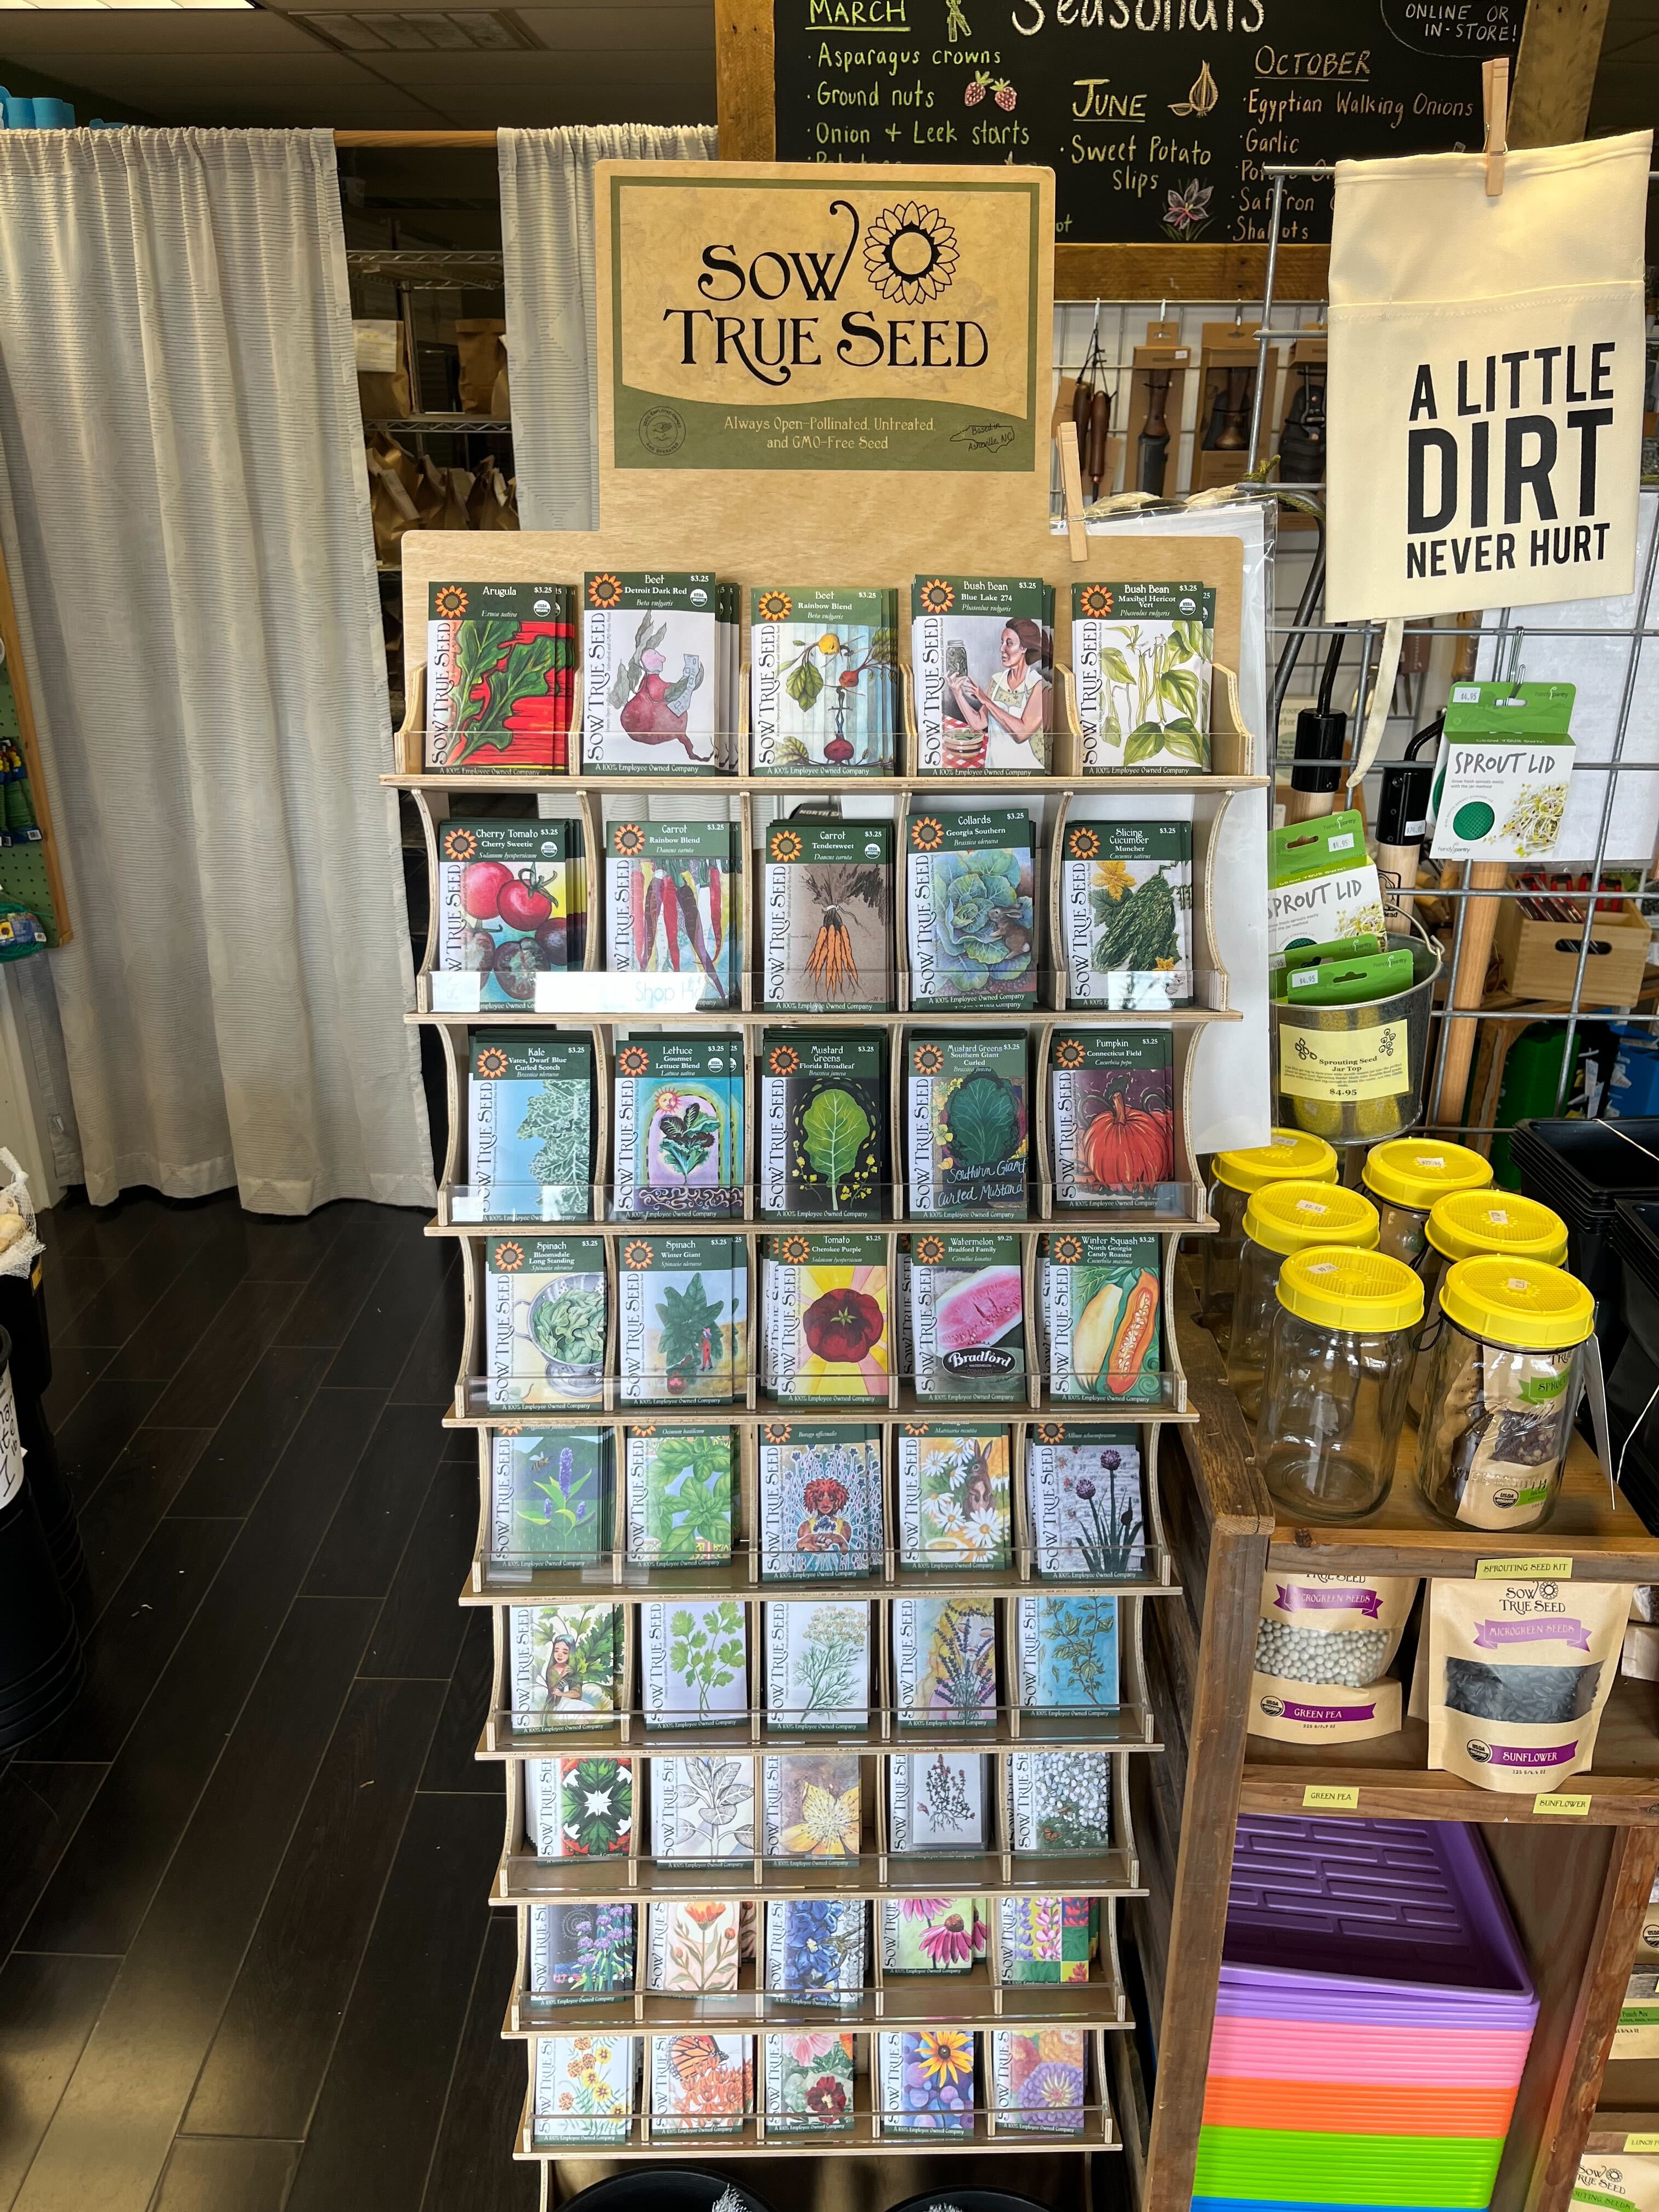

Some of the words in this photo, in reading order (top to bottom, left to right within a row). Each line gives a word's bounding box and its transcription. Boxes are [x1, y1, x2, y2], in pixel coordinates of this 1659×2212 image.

[810, 0, 906, 24] MARCH
[1405, 3, 1471, 20] ONLINE
[1487, 6, 1509, 23] OR
[818, 43, 919, 76] Asparagus
[933, 50, 1001, 65] crowns
[1255, 46, 1370, 76] OCTOBER
[817, 82, 878, 106] Ground
[892, 81, 934, 107] nuts
[1073, 79, 1147, 117] JUNE
[1249, 88, 1322, 124] Egyptian
[1338, 91, 1404, 128] Walking
[1413, 93, 1473, 116] Onions
[816, 122, 870, 144] Onion
[914, 121, 957, 143] Leek
[972, 121, 1029, 144] starts
[1246, 129, 1299, 153] Garlic
[1071, 135, 1136, 163] Sweet
[1149, 137, 1211, 165] Potato
[1113, 166, 1159, 198] slips
[698, 200, 859, 301] SOW
[663, 308, 821, 386] TRUE
[837, 311, 988, 367] SEED
[1409, 364, 1437, 421] A
[1458, 342, 1615, 416] LITTLE
[725, 416, 770, 431] Always
[767, 436, 788, 449] and
[792, 436, 855, 450] GMO-Free
[858, 436, 889, 449] Seed
[1408, 408, 1613, 534] DIRT
[1407, 533, 1515, 579] NEVER
[1531, 523, 1610, 567] HURT
[645, 574, 665, 584] Beet
[963, 580, 986, 590] Bush
[988, 581, 1008, 590] Bean
[1125, 584, 1146, 593] Bush
[1148, 584, 1170, 594] Bean
[483, 586, 517, 597] Arugula
[815, 590, 834, 600] Beet
[980, 594, 997, 602] Lake
[1460, 693, 1477, 702] $4.95
[1455, 752, 1526, 775] SPROUT
[1528, 754, 1555, 774] LID
[958, 816, 991, 826] Collards
[476, 829, 505, 840] Cherry
[507, 829, 538, 838] Tomato
[662, 824, 687, 834] Carrot
[946, 828, 973, 837] Georgia
[1116, 828, 1143, 838] Slicing
[820, 831, 845, 840] Carrot
[1109, 836, 1149, 844] Cucumber
[481, 840, 504, 848] Cherry
[1336, 879, 1362, 900] LID
[1299, 974, 1315, 985] $4.95
[947, 1044, 977, 1053] Mustard
[979, 1044, 1002, 1053] Greens
[1096, 1039, 1128, 1048] Pumpkin
[528, 1047, 545, 1057] Kale
[663, 1046, 693, 1056] Lettuce
[811, 1046, 843, 1054] Mustard
[509, 1057, 528, 1065] Vates,
[814, 1054, 840, 1063] Greens
[946, 1164, 995, 1184] Southern
[997, 1158, 1028, 1176] Giant
[938, 1188, 976, 1207] Curled
[980, 1182, 1024, 1202] Mustard
[666, 1240, 696, 1249] Spinach
[823, 1235, 850, 1244] Tomato
[950, 1237, 994, 1246] Watermelon
[1082, 1236, 1107, 1245] Winter
[1109, 1236, 1138, 1245] Squash
[537, 1242, 567, 1250] Spinach
[948, 1351, 1012, 1368] Bradford
[905, 1439, 917, 1476] SEED
[905, 1480, 922, 1515] TRUE
[905, 1517, 918, 1560] SOW
[1484, 1564, 1529, 1572] SPROUTING
[1506, 1581, 1539, 1598] SOW
[1499, 1599, 1531, 1615] TRUE
[1534, 1598, 1565, 1612] SEED
[1489, 1625, 1543, 1638] MICROGREEN
[1547, 1624, 1575, 1634] SEEDS
[1294, 1708, 1322, 1718] GREEN
[1325, 1710, 1342, 1718] PEA
[1503, 1751, 1557, 1762] SUNFLOWER
[1311, 1792, 1335, 1801] GREEN
[1338, 1793, 1352, 1801] PEA
[1539, 1799, 1585, 1808] SUNFLOWER
[1599, 2181, 1625, 2194] SEED
